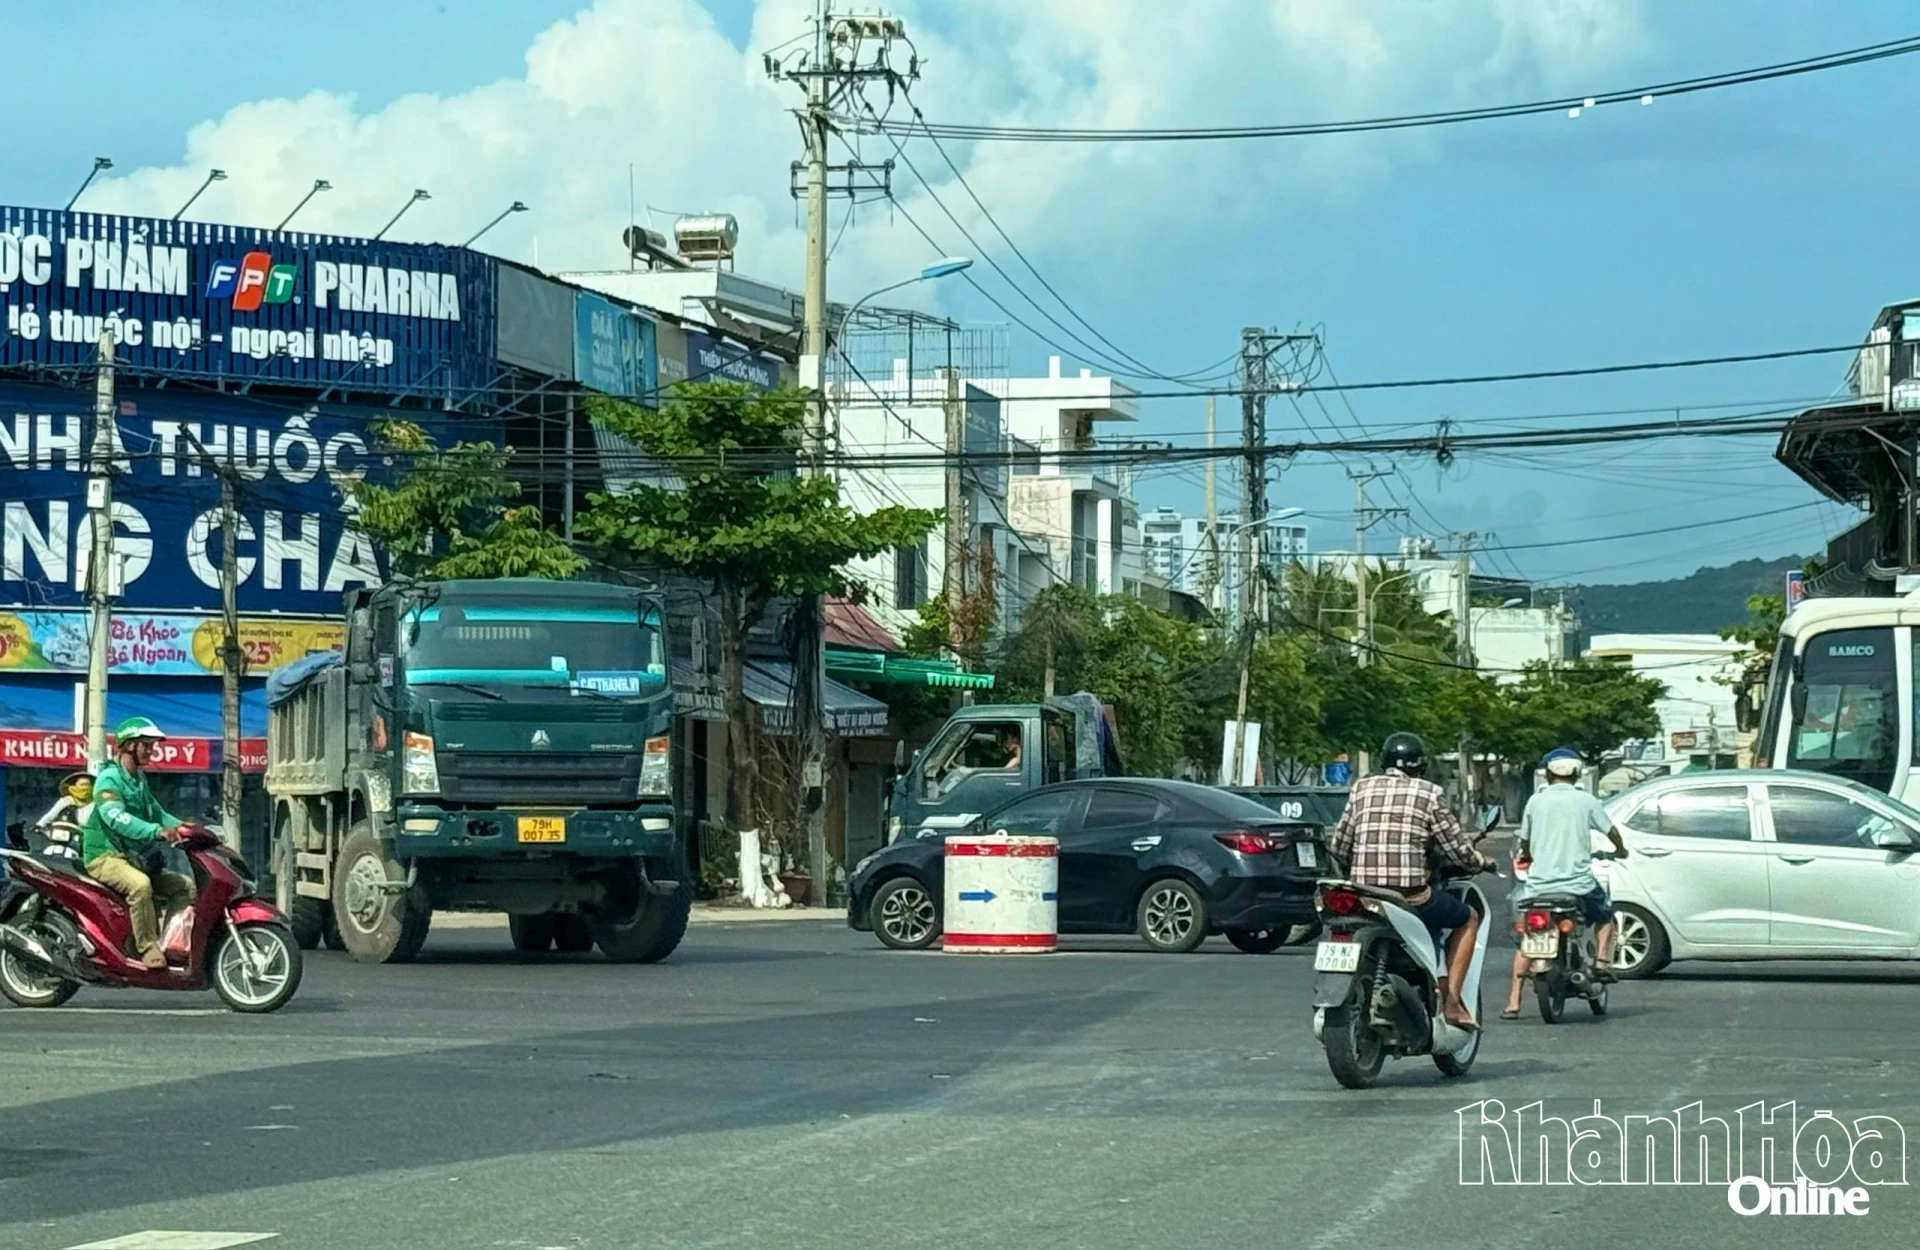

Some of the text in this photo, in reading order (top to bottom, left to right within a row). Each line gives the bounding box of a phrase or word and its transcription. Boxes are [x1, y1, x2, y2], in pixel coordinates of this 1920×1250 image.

[66, 221, 188, 296] PHẨM
[210, 261, 297, 301] FPT
[315, 261, 461, 322] PHARMA
[50, 308, 143, 346] thuốc
[153, 316, 201, 355] nội
[232, 326, 315, 363] ngoại
[323, 331, 394, 368] nhập
[152, 405, 369, 484] THUỐC
[132, 643, 187, 667] Ngoan
[5, 735, 68, 759] KHIẾU
[182, 741, 195, 764] Ý
[1281, 801, 1303, 818] 09
[532, 819, 552, 830] 79H
